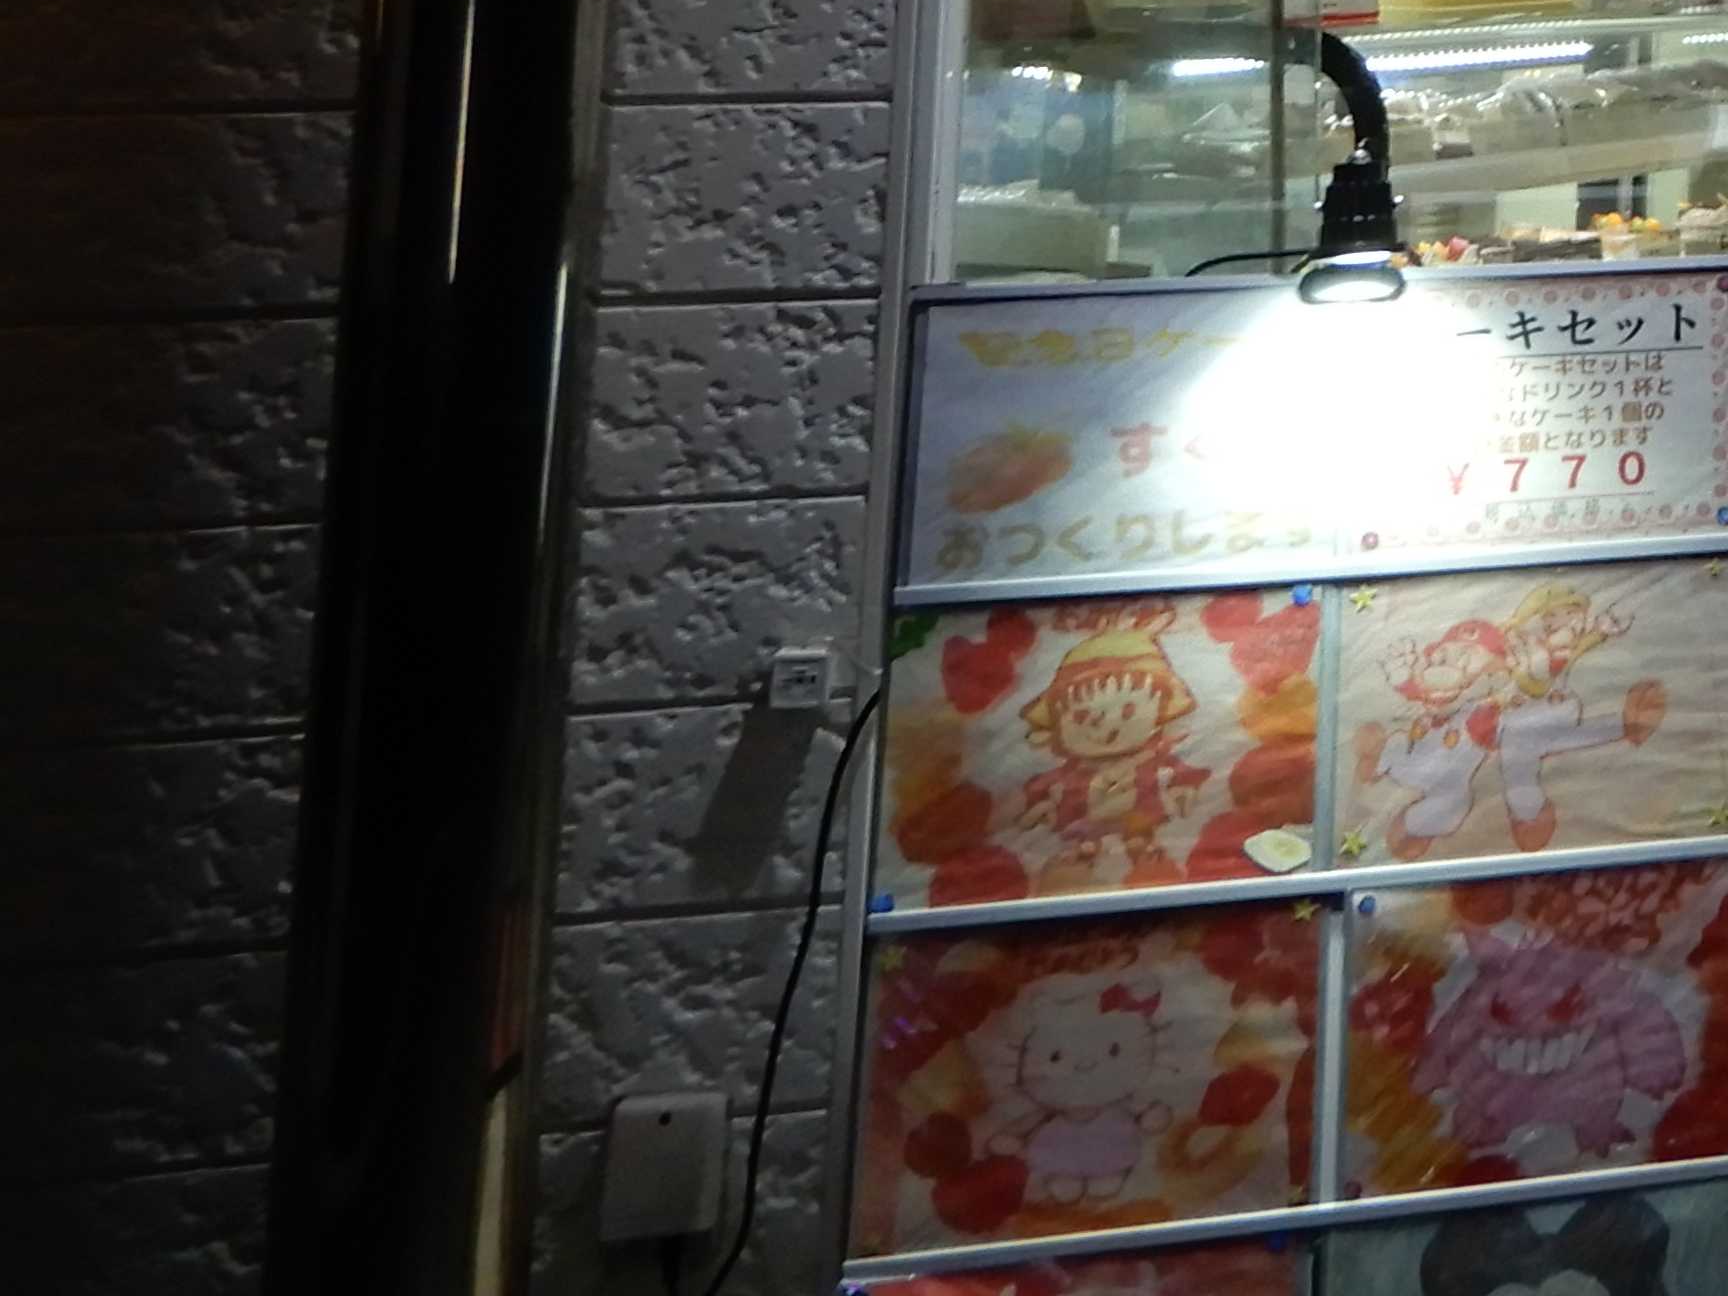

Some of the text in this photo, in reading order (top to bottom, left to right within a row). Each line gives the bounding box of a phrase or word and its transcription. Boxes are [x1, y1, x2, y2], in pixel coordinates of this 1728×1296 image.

[1456, 303, 1698, 350] ーキセット
